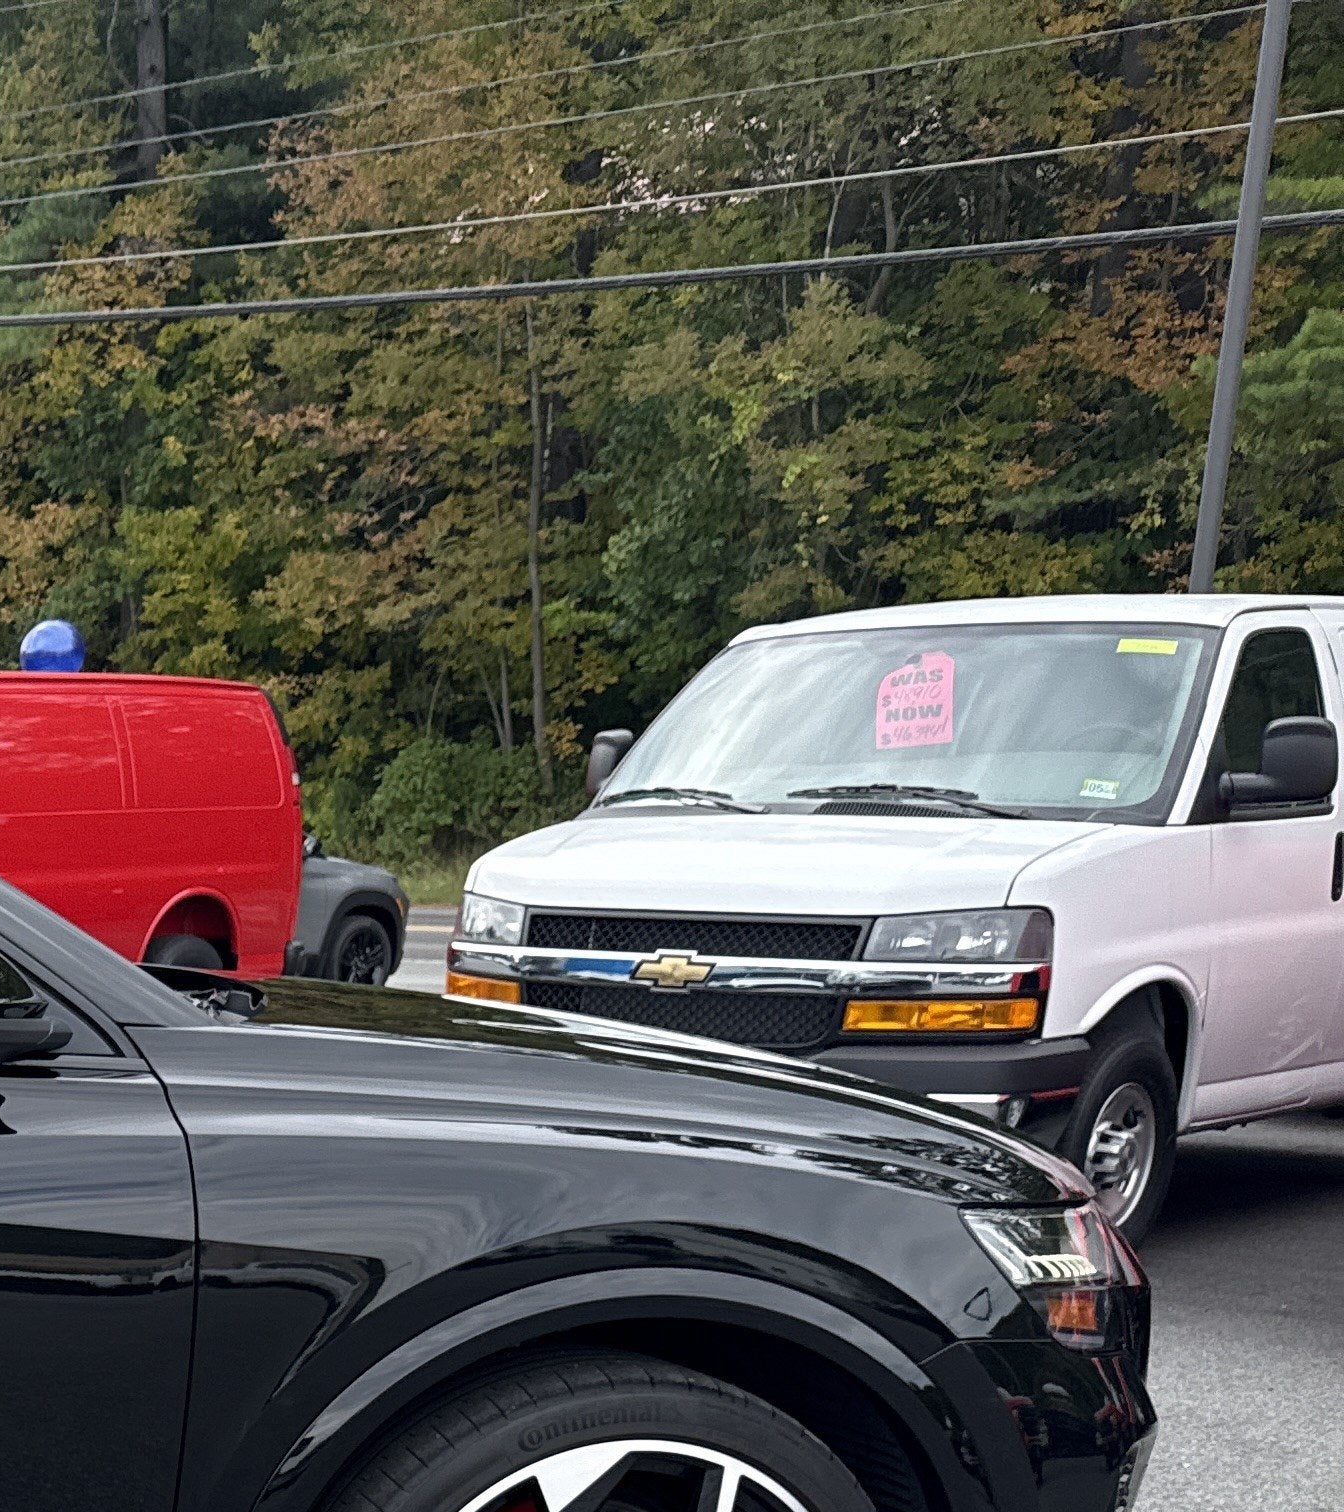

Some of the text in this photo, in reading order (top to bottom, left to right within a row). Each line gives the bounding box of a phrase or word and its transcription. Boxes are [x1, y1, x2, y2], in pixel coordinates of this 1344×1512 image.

[890, 668, 944, 687] WAS
[885, 704, 944, 723] NOW
[517, 1404, 666, 1451] Continental
